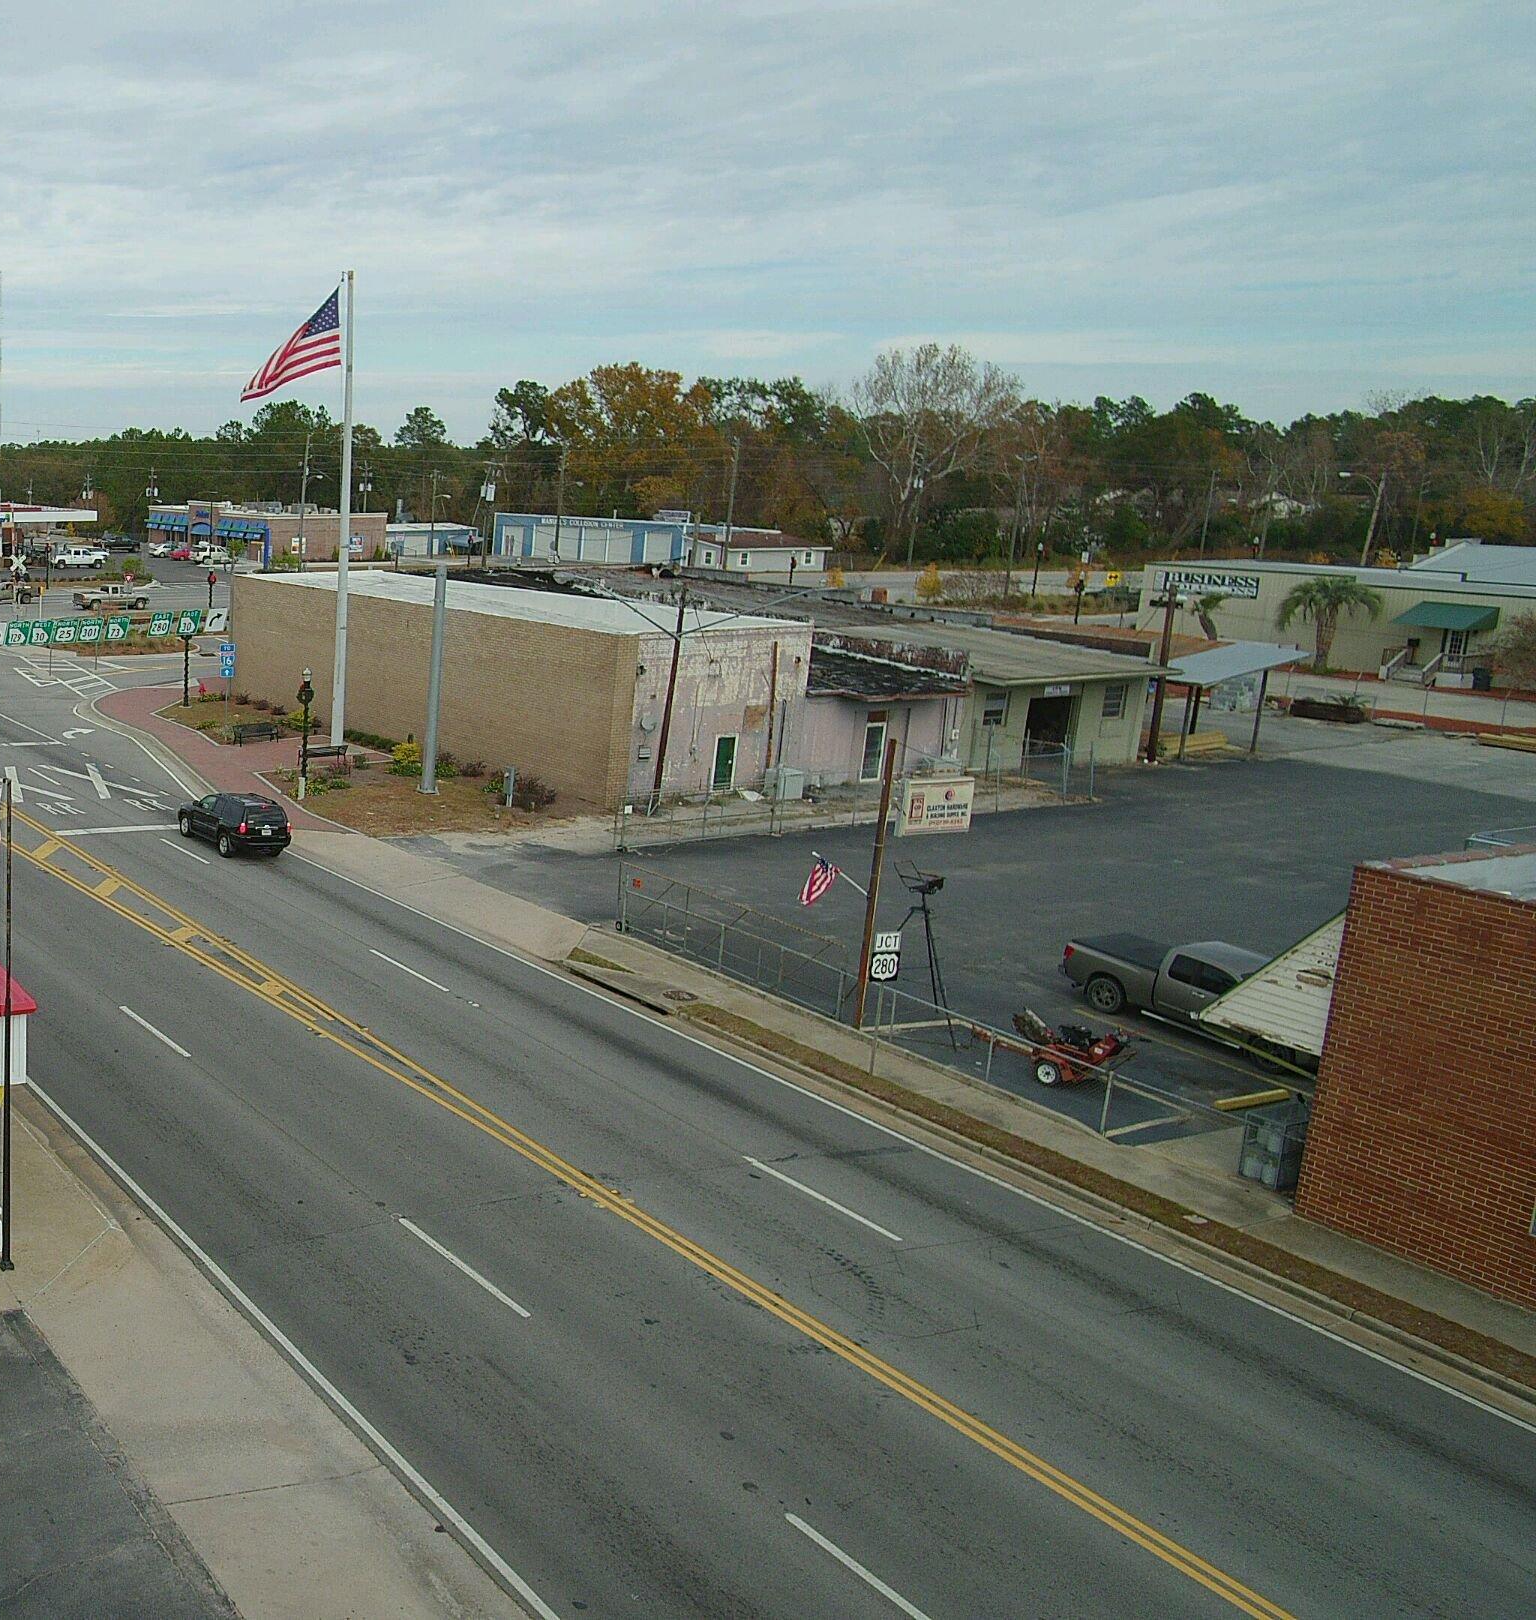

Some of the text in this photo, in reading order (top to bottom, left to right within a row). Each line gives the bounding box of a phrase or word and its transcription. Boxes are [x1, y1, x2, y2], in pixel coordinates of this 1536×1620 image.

[1168, 572, 1257, 587] BUSINESS
[152, 623, 166, 632] 280
[182, 622, 191, 631] 30
[59, 629, 72, 638] 25
[82, 627, 97, 636] 301
[111, 628, 120, 637] 73
[11, 633, 21, 642] 129
[35, 632, 44, 641] 30
[223, 656, 232, 665] 16
[877, 935, 900, 949] JCT
[874, 958, 896, 975] 280
